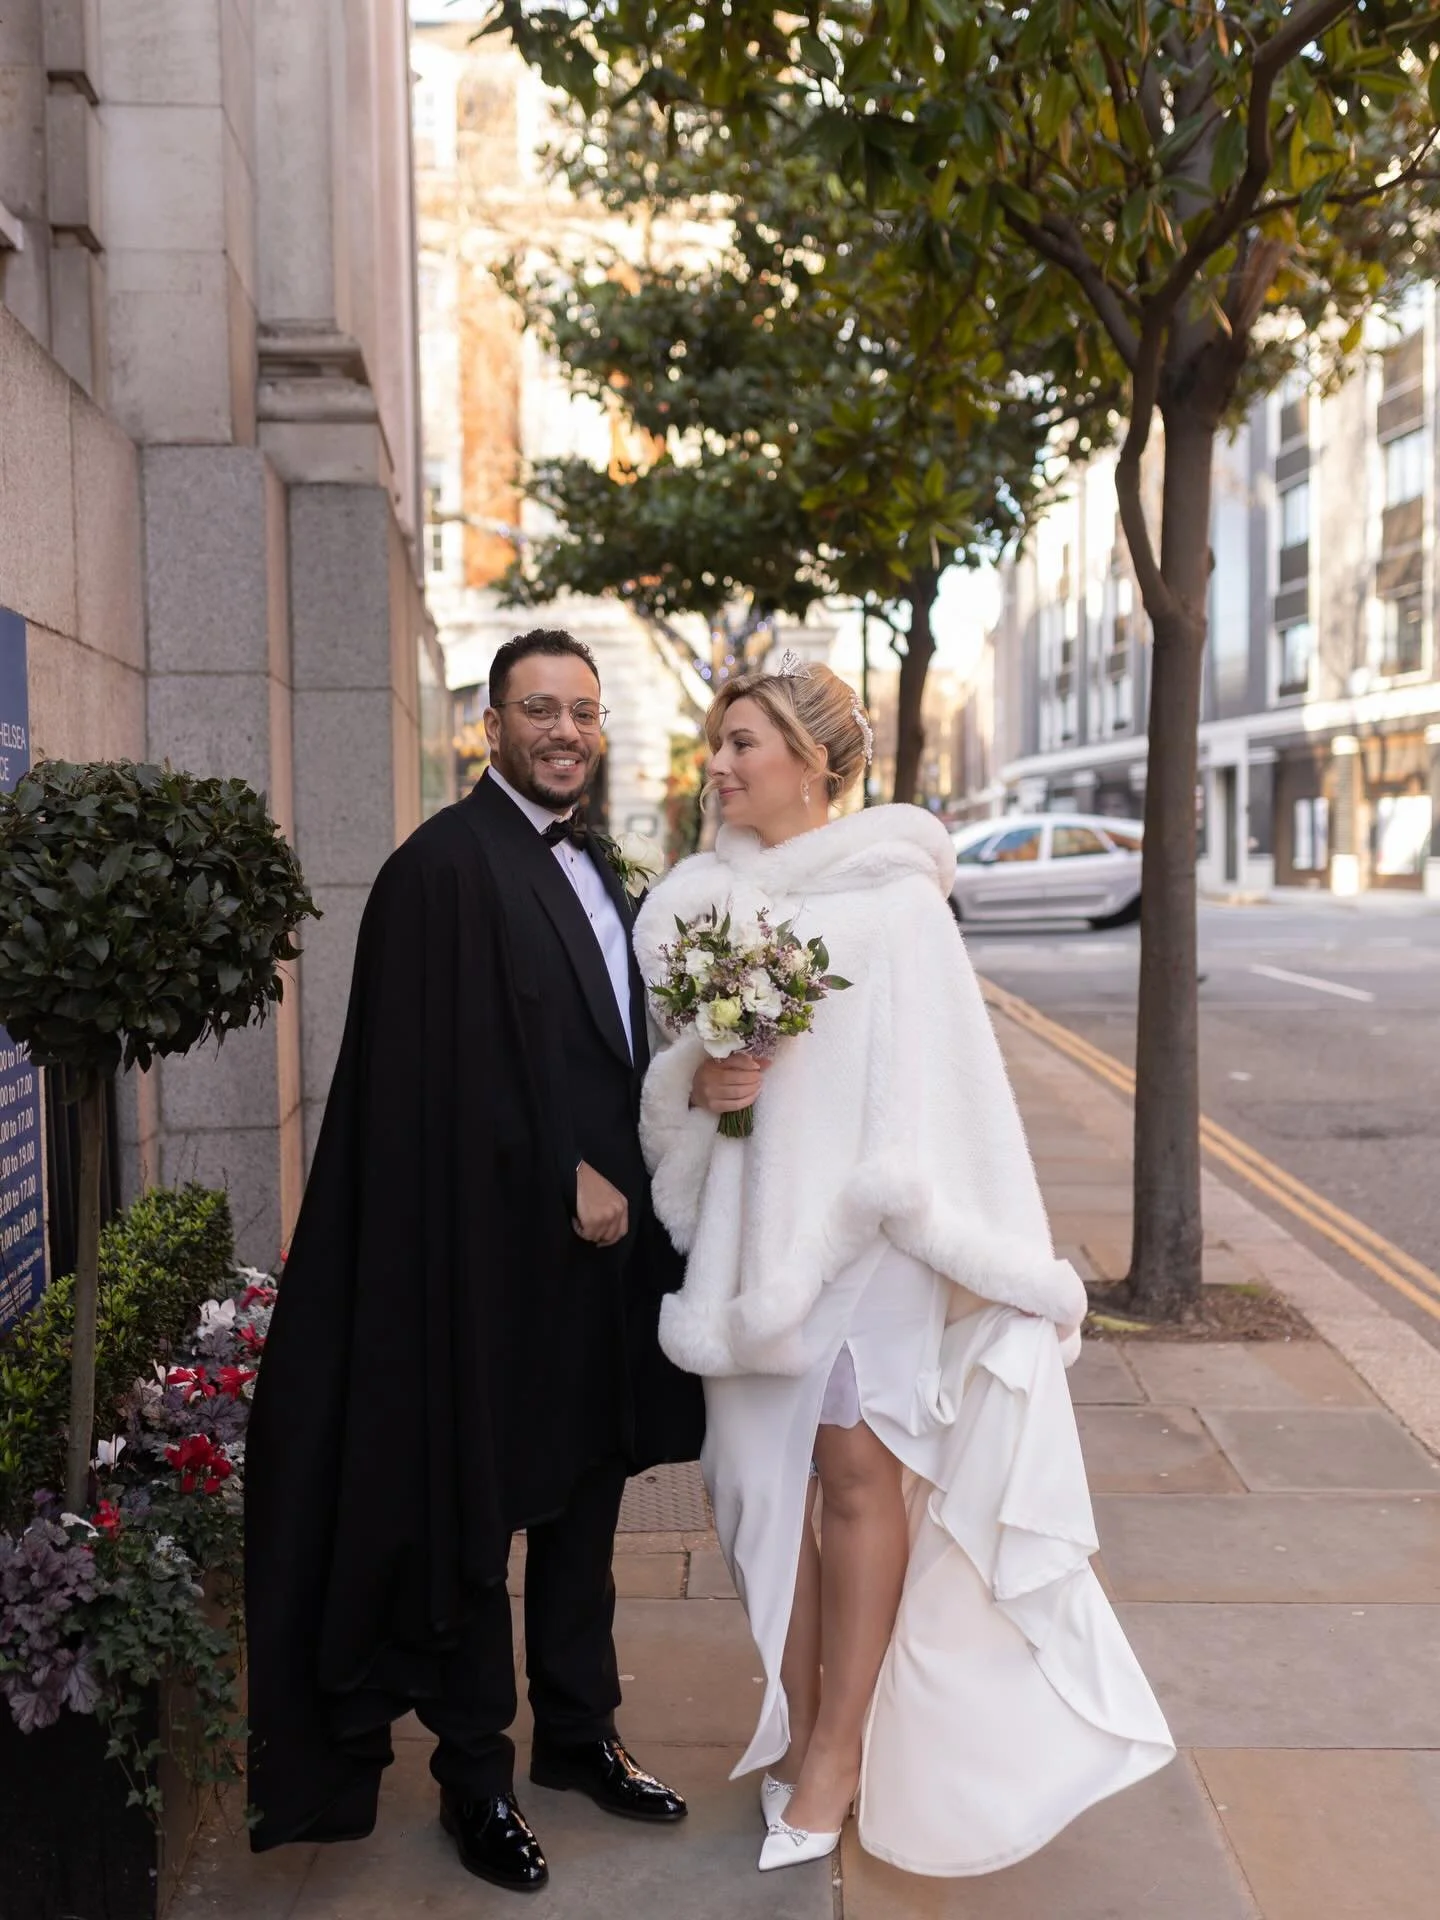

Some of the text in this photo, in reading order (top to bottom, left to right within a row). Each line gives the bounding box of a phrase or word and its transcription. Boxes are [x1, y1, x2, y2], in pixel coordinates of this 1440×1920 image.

[8, 1049, 15, 1068] to
[9, 1085, 16, 1103] to
[17, 1073, 33, 1099] 17.00
[10, 1120, 17, 1138] to
[18, 1107, 34, 1133] 17.00
[11, 1155, 18, 1173] to
[19, 1141, 35, 1168] 19.00
[12, 1190, 19, 1208] to
[20, 1174, 36, 1202] 17.00
[13, 1224, 20, 1244] to
